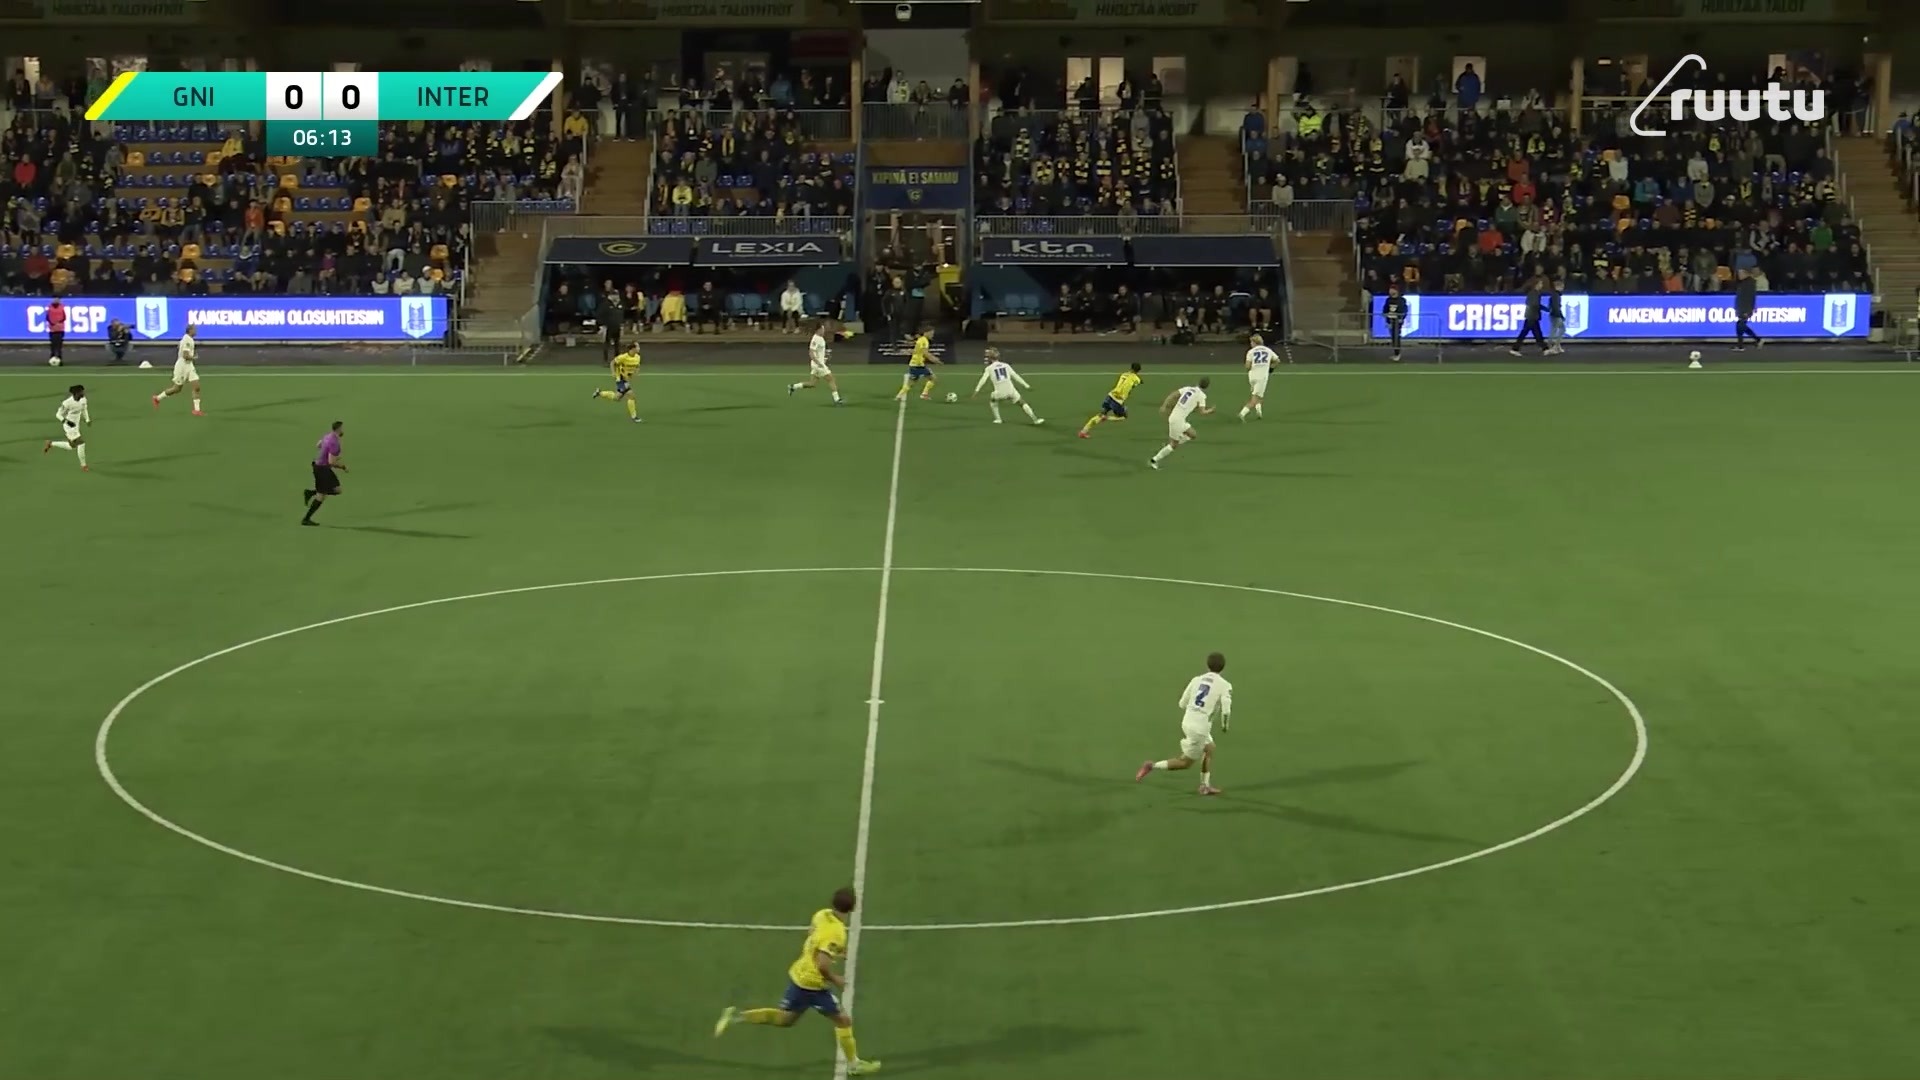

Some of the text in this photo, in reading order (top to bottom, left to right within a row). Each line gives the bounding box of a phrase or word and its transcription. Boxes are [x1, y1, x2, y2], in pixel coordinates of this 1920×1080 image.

[908, 172, 919, 185] EI
[711, 242, 823, 253] LEXIA
[27, 305, 107, 333] CISP
[187, 309, 385, 326] KAIKENLAISIIN OLOSUHTEISIIN
[1608, 307, 1706, 323] KAIKENLAISIIN
[1253, 351, 1269, 364] 22
[994, 367, 1008, 381] 14
[1195, 683, 1211, 708] 2
